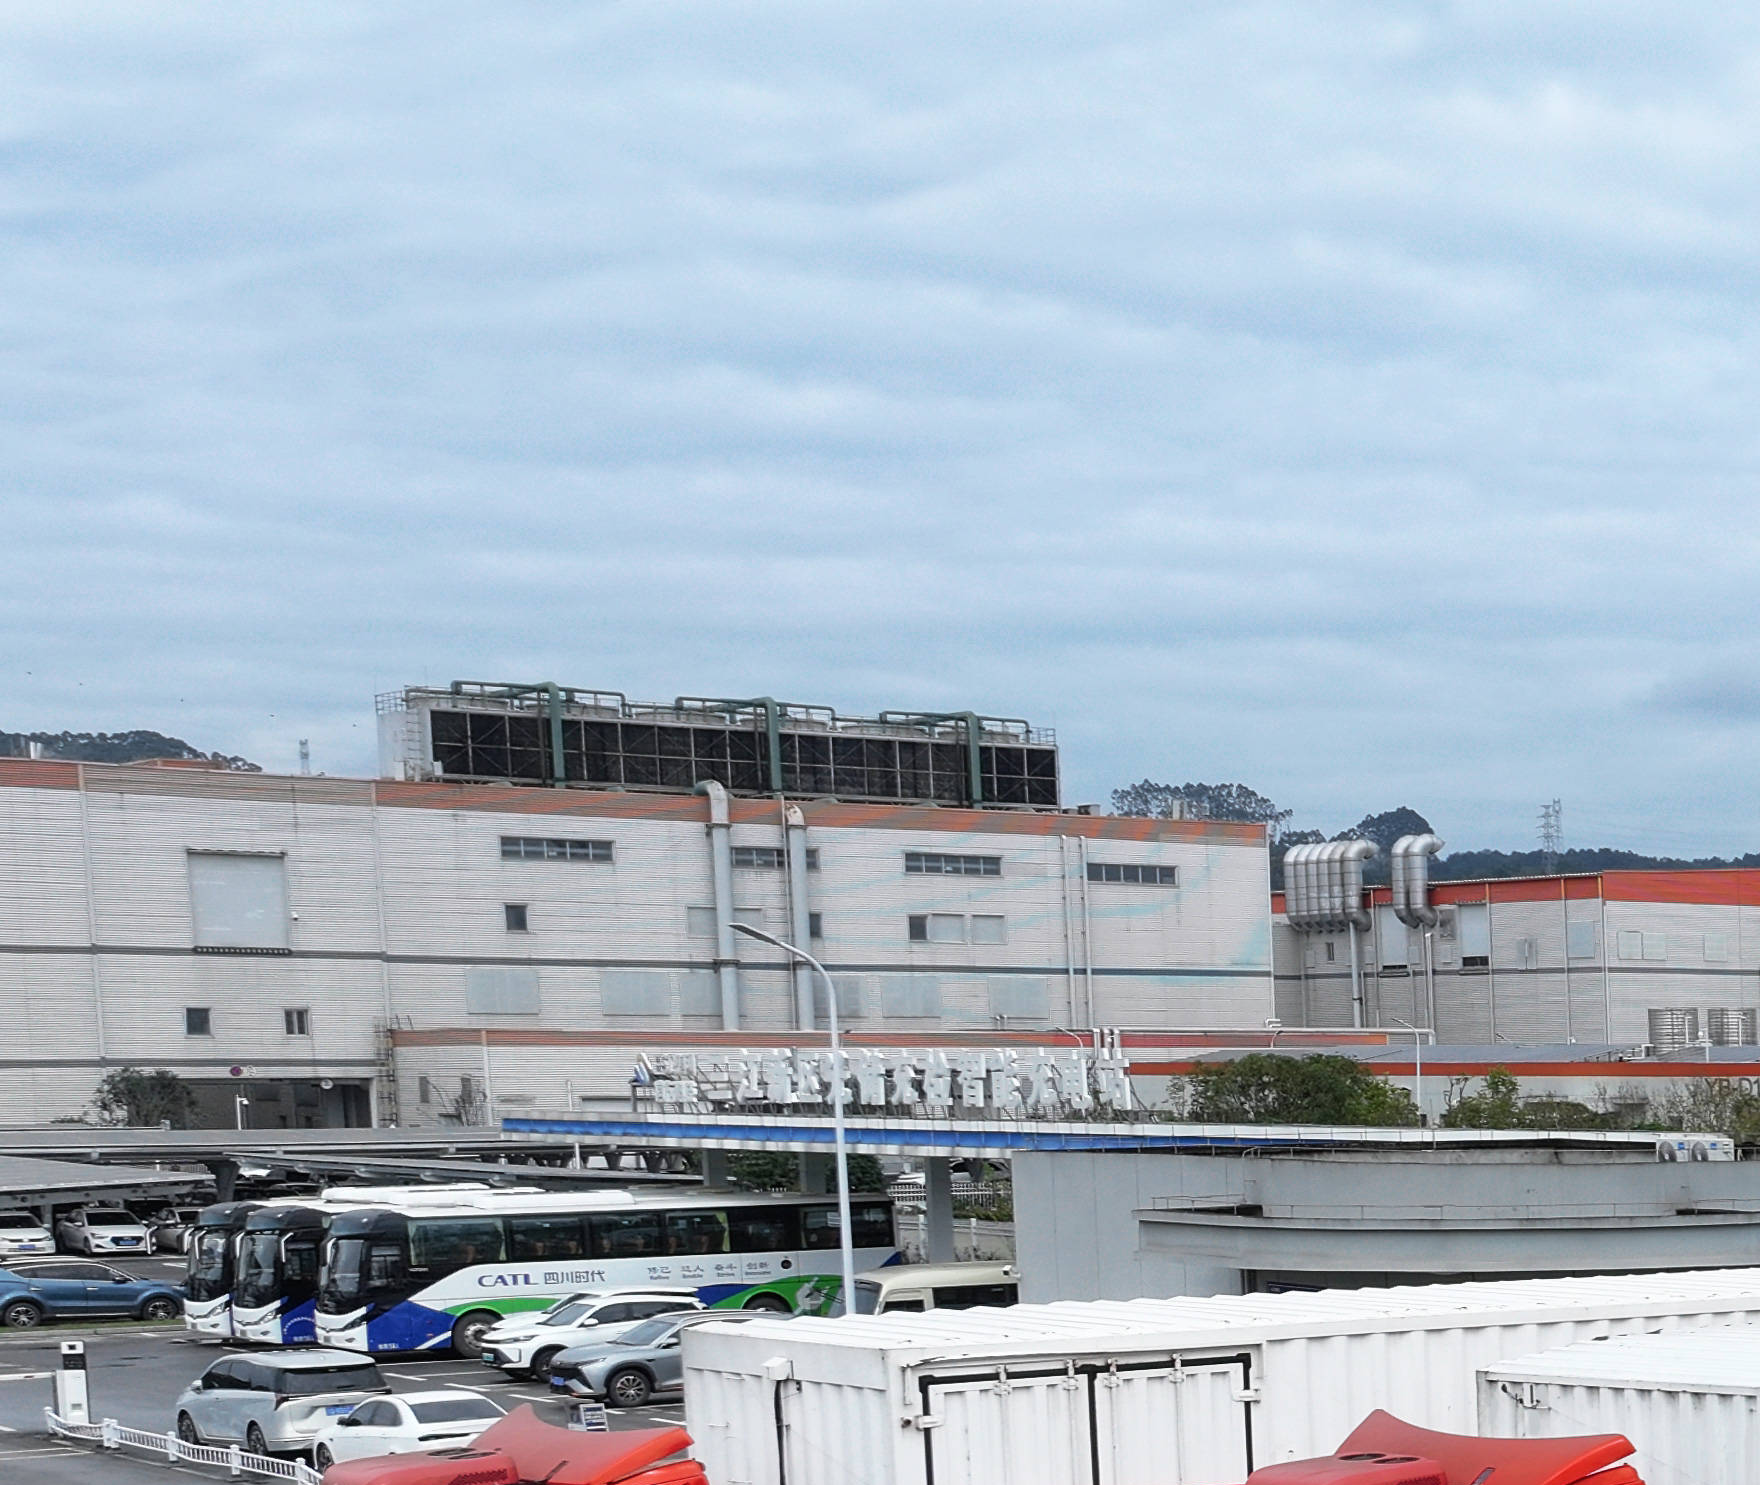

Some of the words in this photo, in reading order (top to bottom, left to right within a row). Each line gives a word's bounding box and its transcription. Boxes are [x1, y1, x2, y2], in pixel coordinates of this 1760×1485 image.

[478, 1272, 540, 1288] CATL
[543, 1269, 606, 1285] 四川时代
